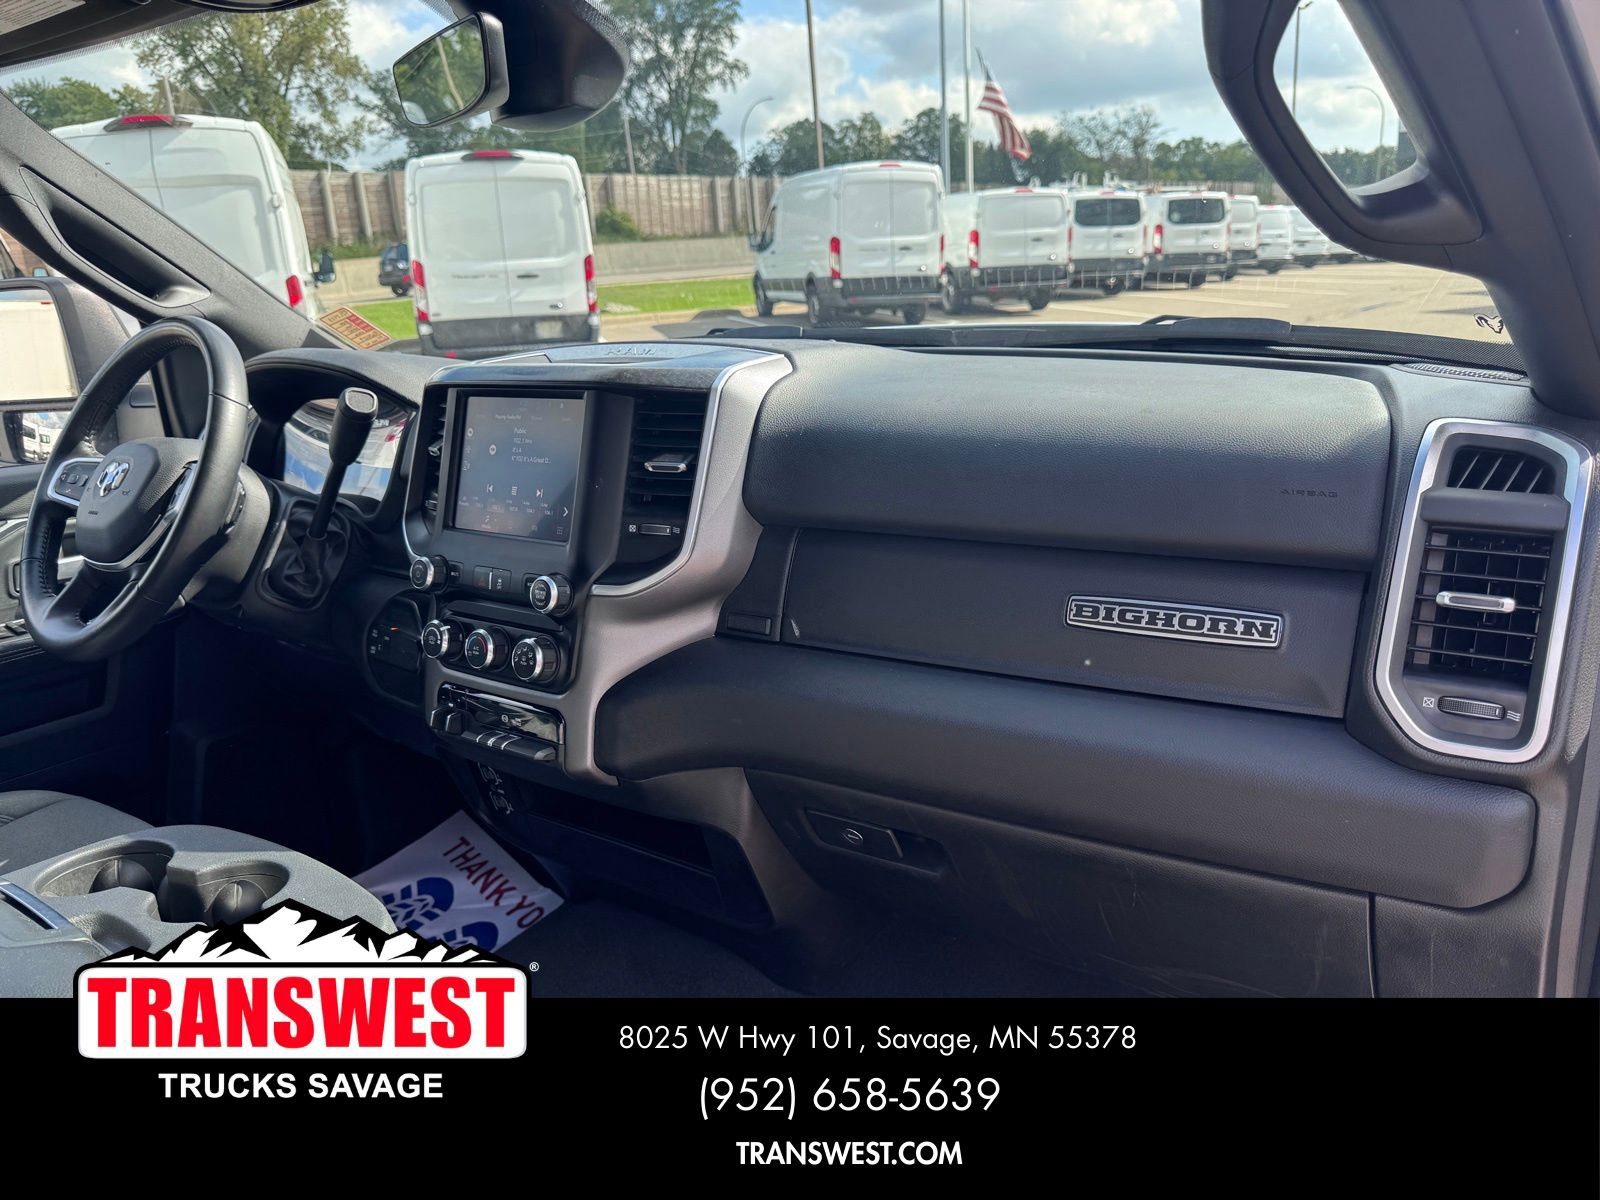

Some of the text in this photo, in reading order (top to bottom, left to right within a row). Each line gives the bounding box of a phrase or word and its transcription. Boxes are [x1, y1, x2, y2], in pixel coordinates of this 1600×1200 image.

[1280, 489, 1338, 498] AIRBAG
[1069, 601, 1280, 642] BIGHORN
[443, 836, 516, 907] THANK
